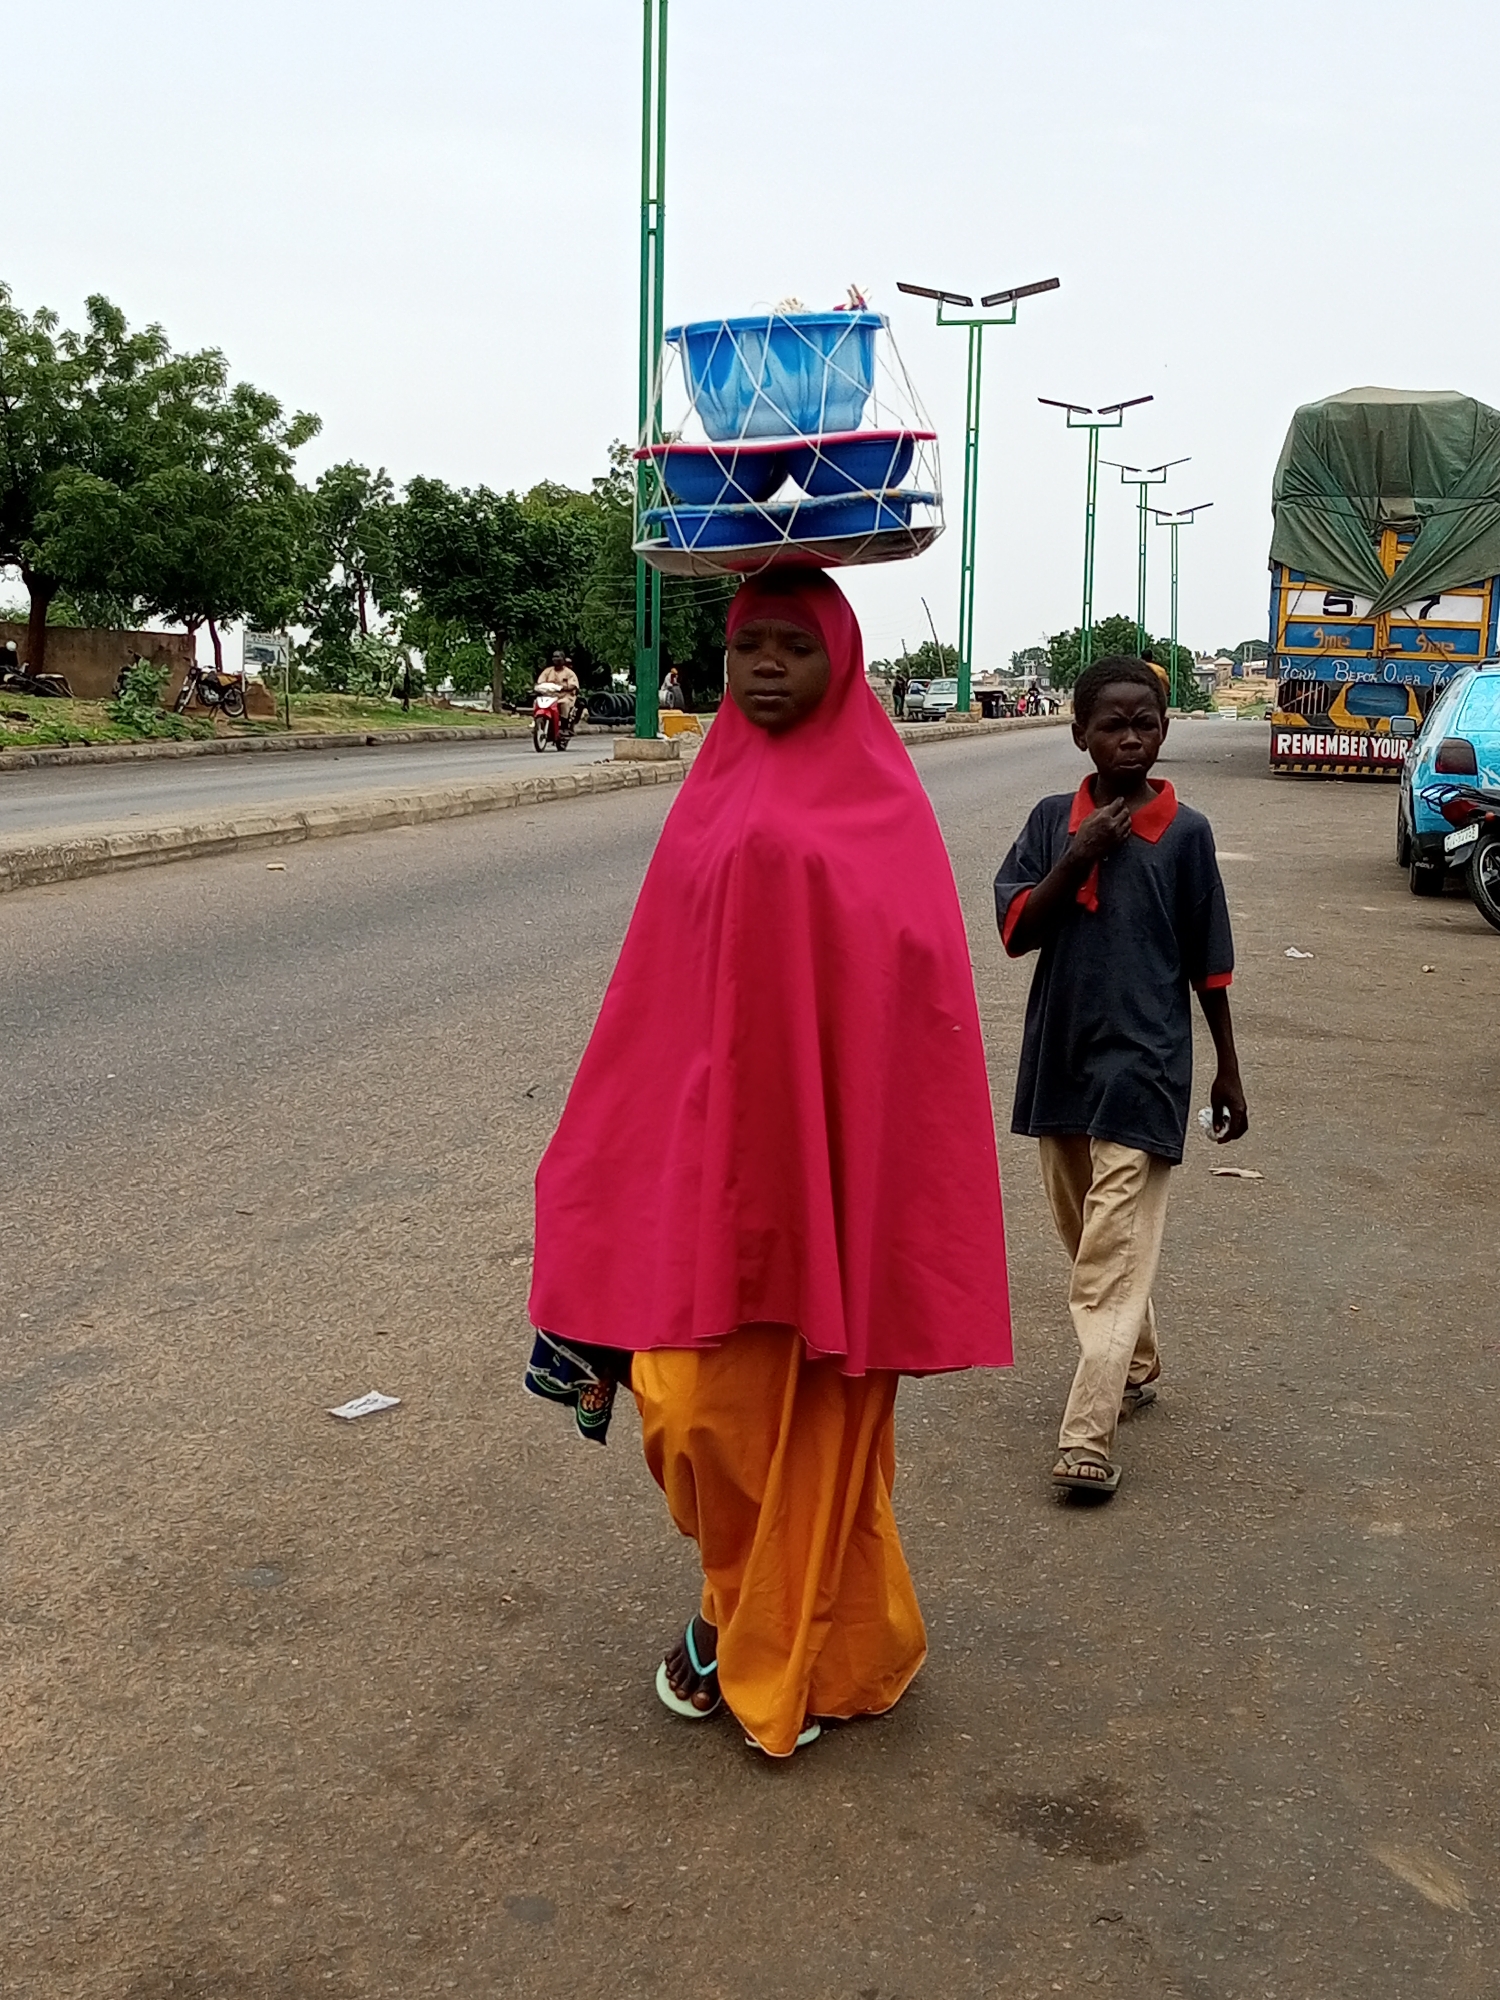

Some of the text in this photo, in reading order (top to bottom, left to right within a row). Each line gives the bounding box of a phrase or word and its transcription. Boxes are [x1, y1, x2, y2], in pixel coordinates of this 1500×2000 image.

[1323, 592, 1354, 616] 5
[1415, 594, 1441, 619] 7
[1277, 733, 1408, 759] REMEMBER YOUR
